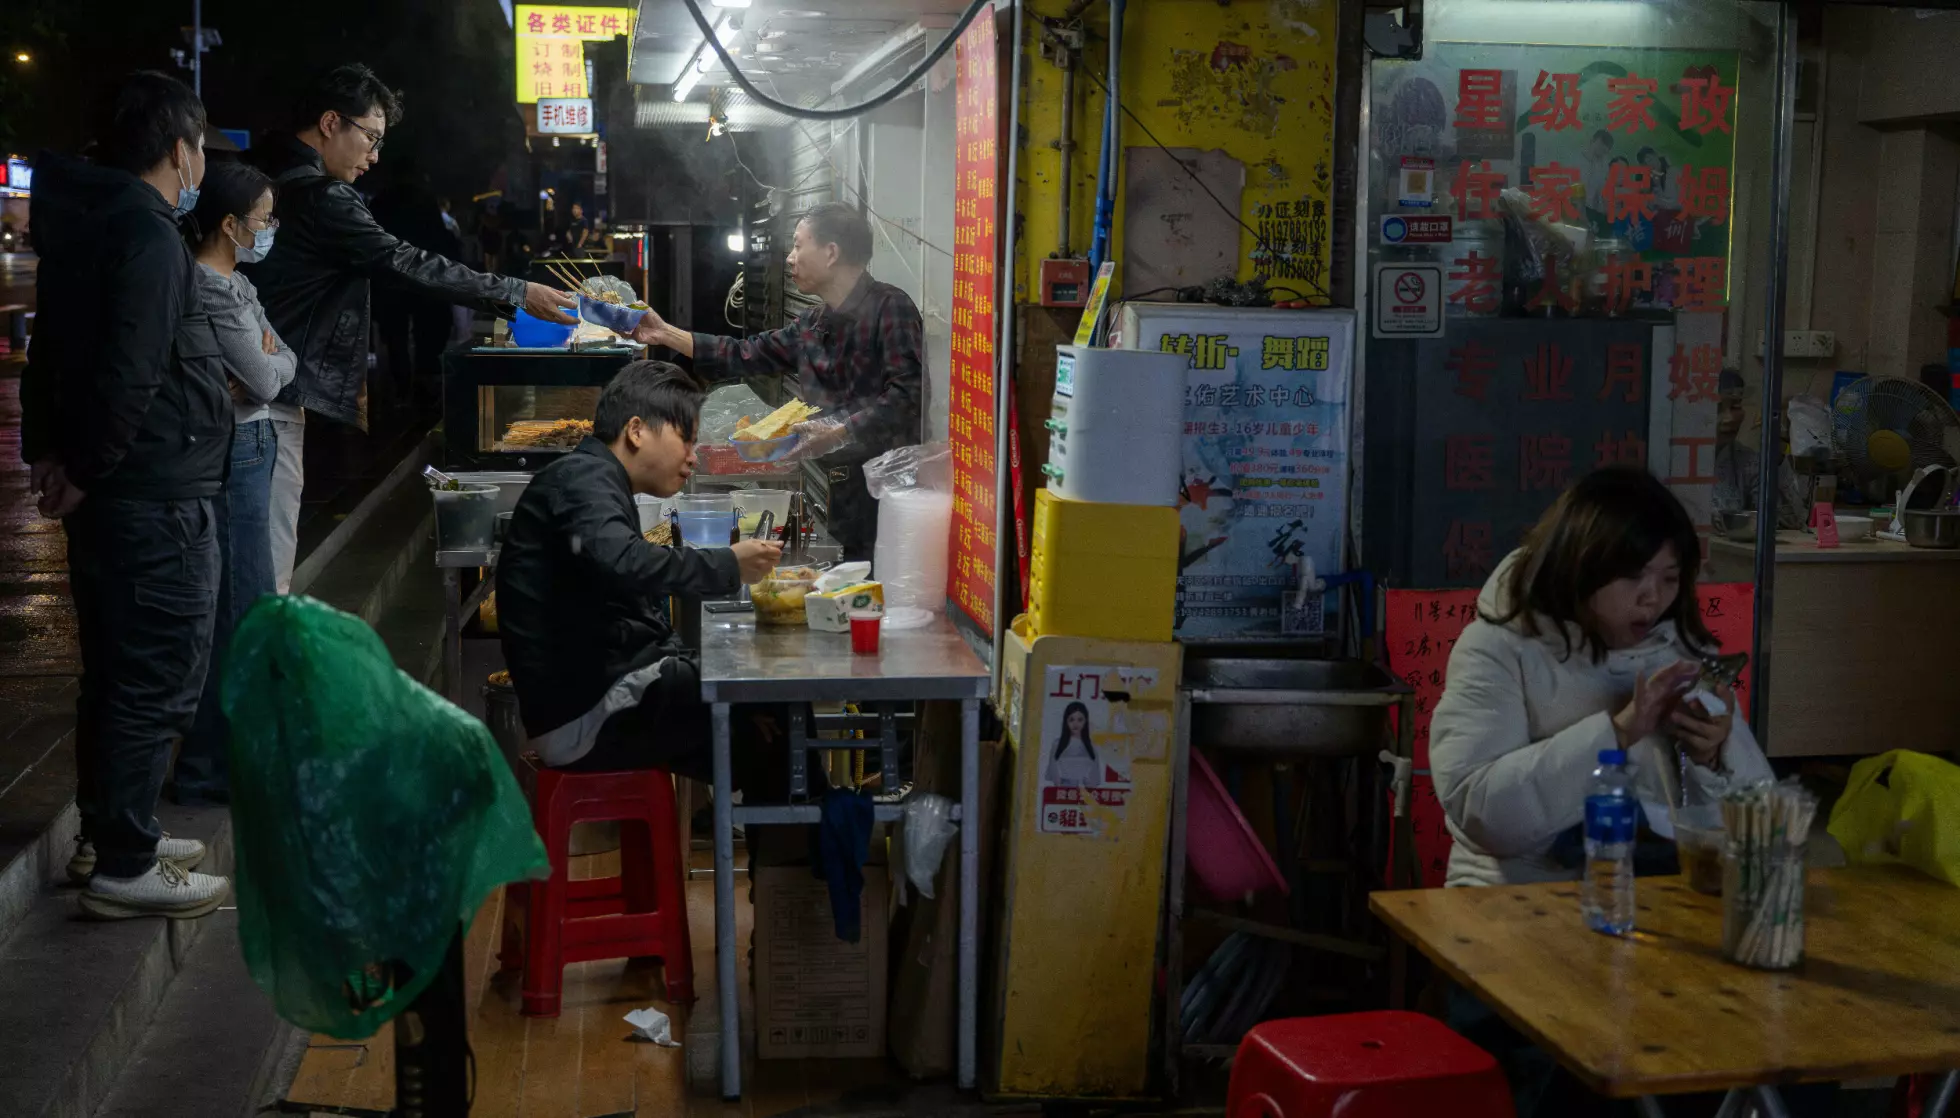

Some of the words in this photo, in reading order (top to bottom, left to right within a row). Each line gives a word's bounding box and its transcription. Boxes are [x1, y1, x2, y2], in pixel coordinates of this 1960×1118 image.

[528, 12, 633, 34] 各类证件
[542, 105, 588, 127] 手机维修
[1453, 69, 1735, 136] 星级家政
[1450, 161, 1731, 226] 住家保姆
[1448, 251, 1729, 316] 老人护理
[1261, 335, 1329, 371] 舞蹈
[1443, 341, 1722, 404] 专业月嫂
[1184, 383, 1314, 408] 佑艺术中心
[1443, 428, 1718, 492] 医院护工
